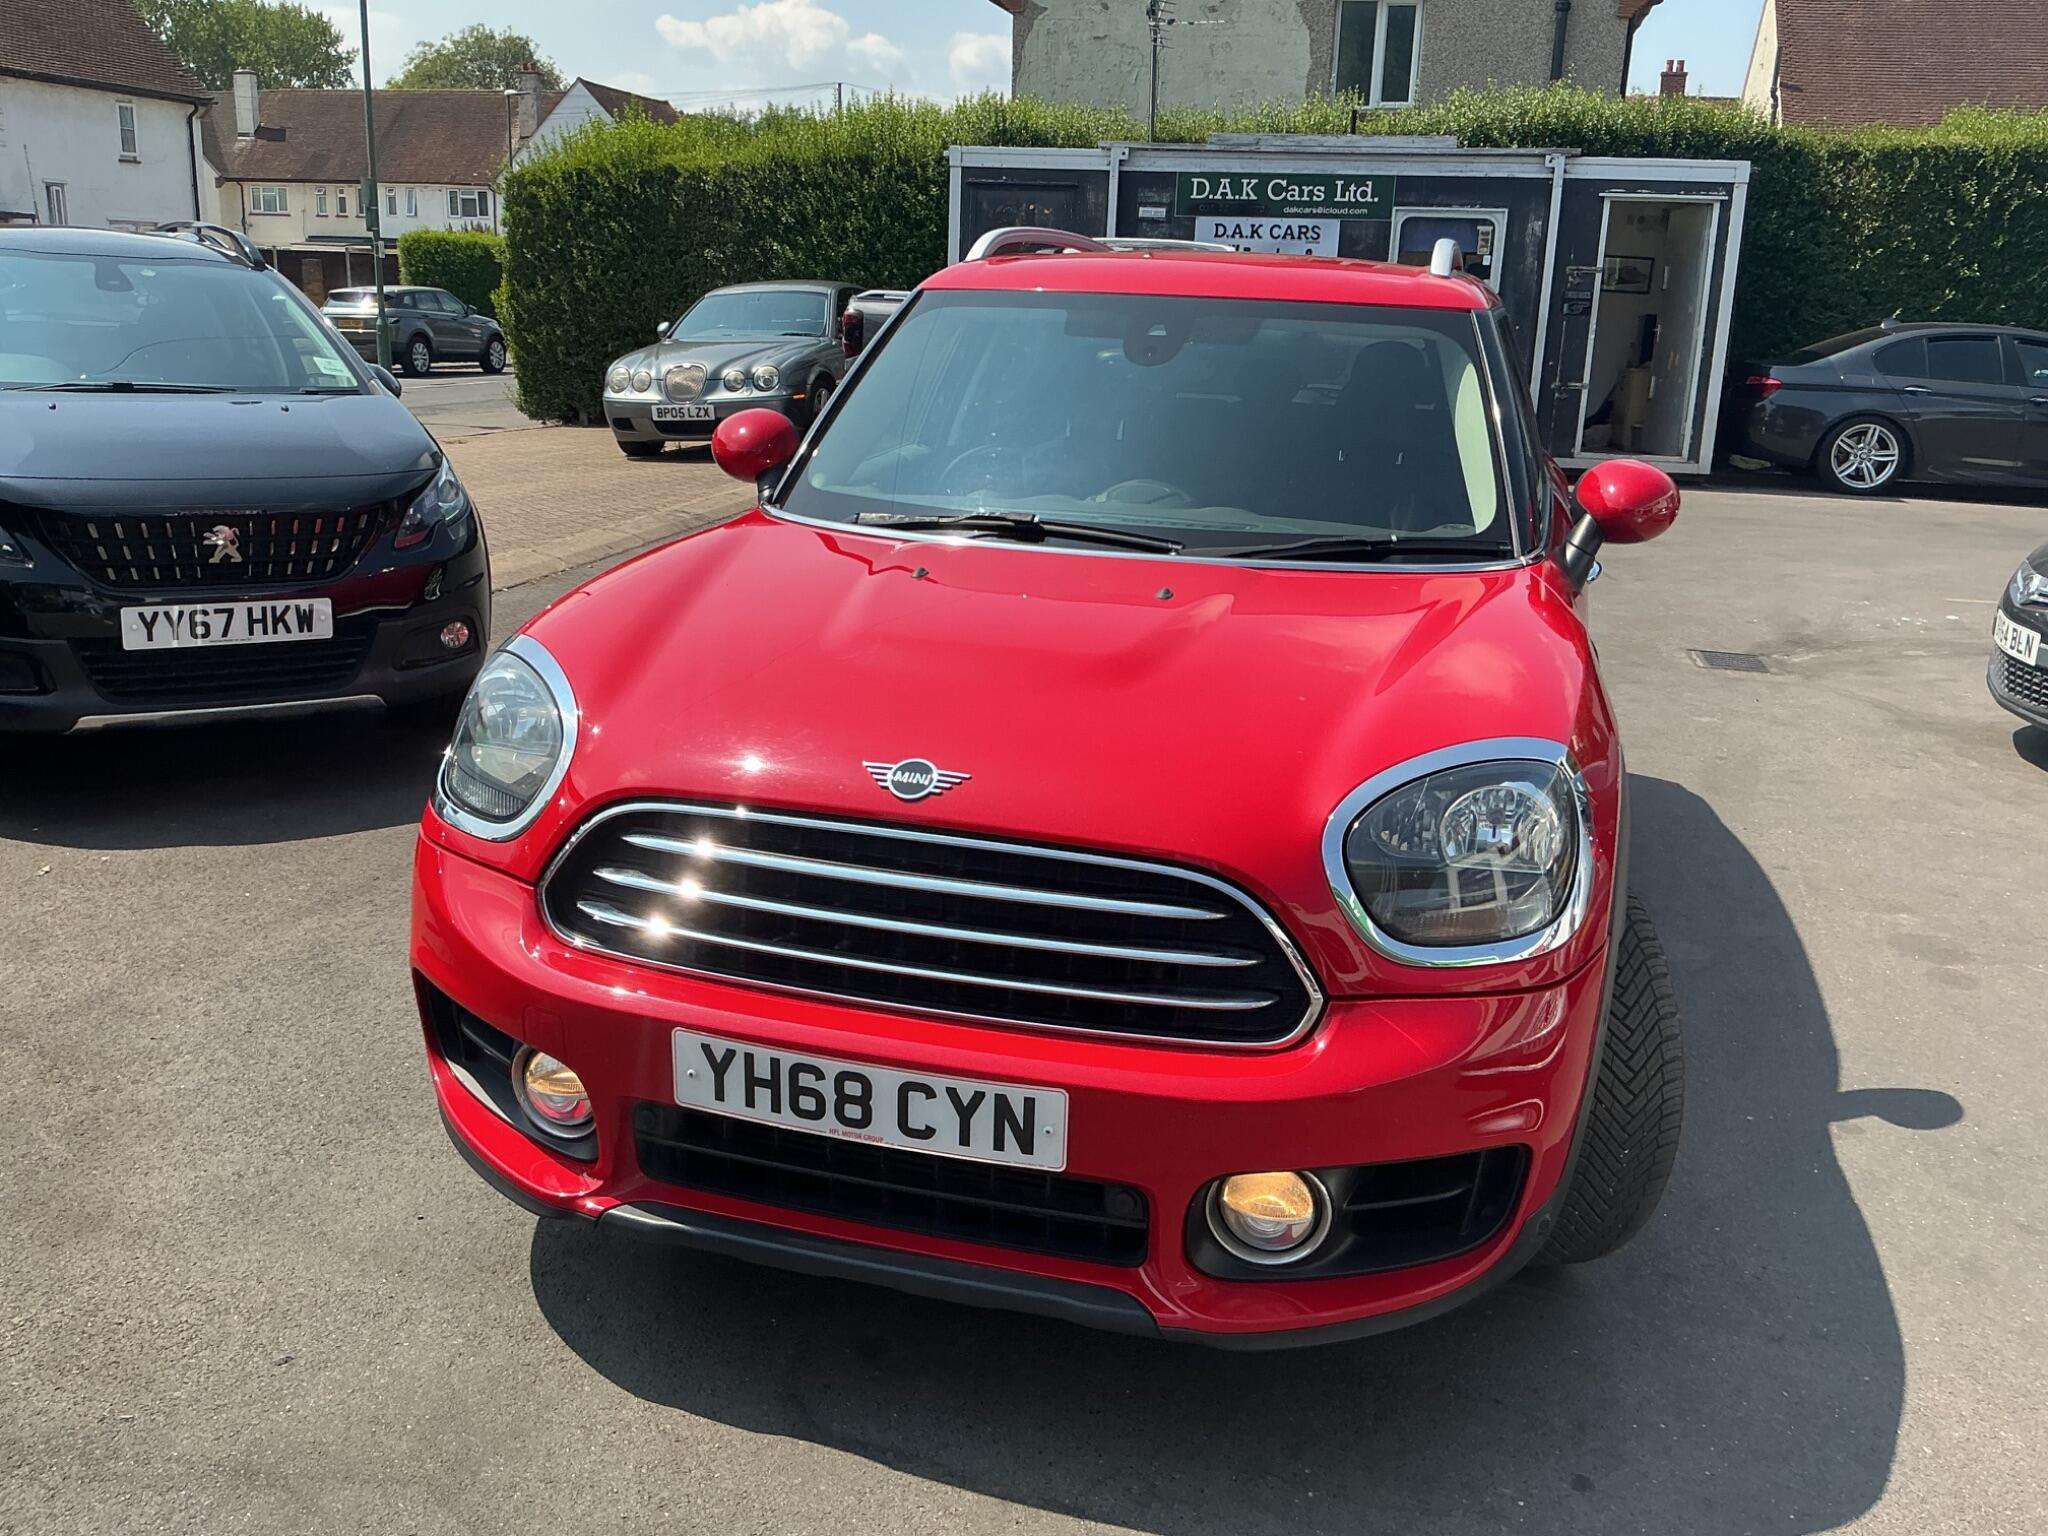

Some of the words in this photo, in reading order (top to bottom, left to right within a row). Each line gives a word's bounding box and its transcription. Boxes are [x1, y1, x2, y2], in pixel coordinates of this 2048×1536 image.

[1190, 177, 1259, 200] D.A.K
[1267, 178, 1325, 202] Cars
[1334, 180, 1379, 203] Ltd.
[1283, 205, 1368, 216] dakcars@icloud.com
[1213, 223, 1264, 240] D.A.K
[1269, 224, 1321, 241] CARS
[656, 407, 685, 419] BP05
[687, 407, 711, 419] LZX
[138, 607, 235, 642] YY67
[247, 603, 315, 637] HKW
[893, 770, 931, 786] MINI
[700, 1042, 873, 1130] YH68
[897, 1080, 1037, 1156] CYN
[863, 1133, 884, 1143] GROUP
